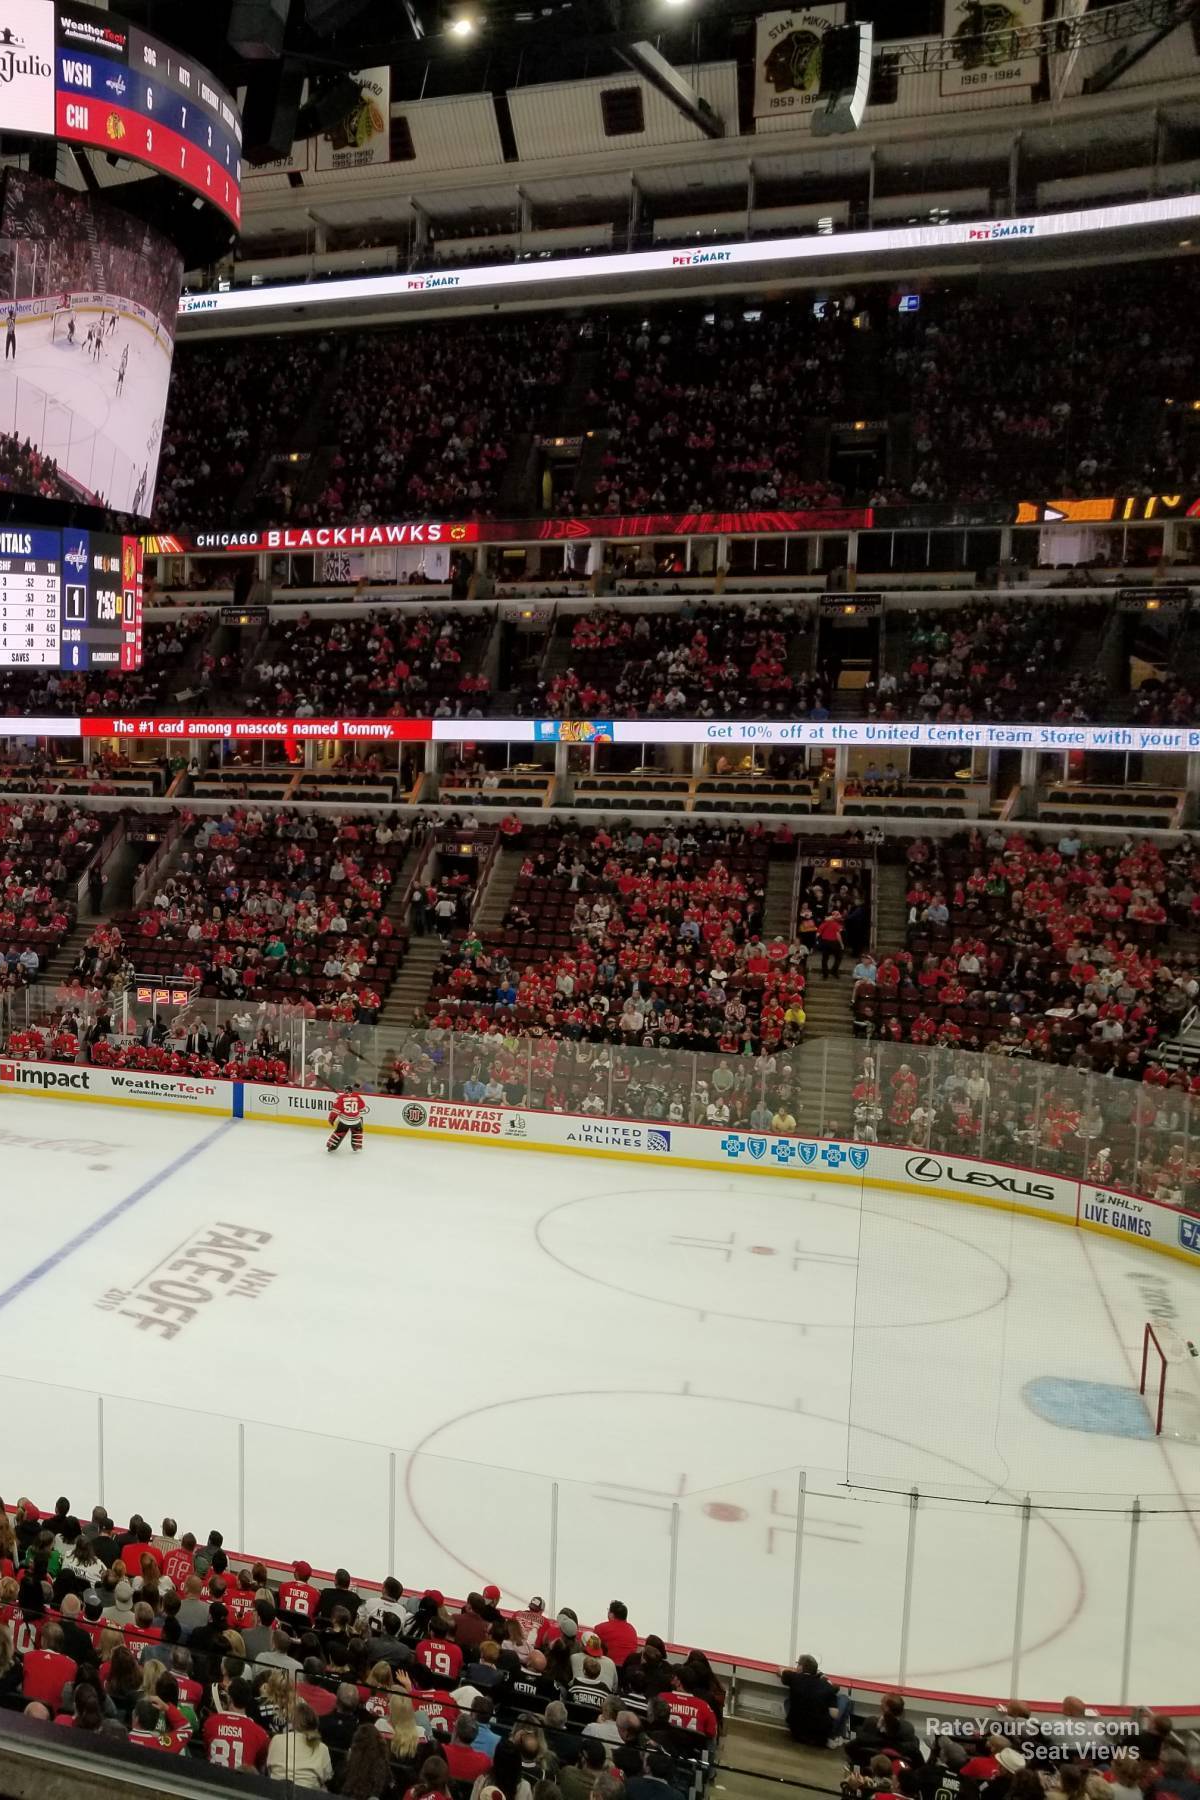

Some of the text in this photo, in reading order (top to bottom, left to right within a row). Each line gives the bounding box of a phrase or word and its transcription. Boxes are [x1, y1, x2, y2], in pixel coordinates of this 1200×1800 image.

[768, 20, 794, 40] STAN
[62, 59, 92, 88] WSH
[66, 104, 89, 131] CHI
[969, 223, 1036, 240] PETSMART
[673, 249, 731, 266] PETSMART
[408, 273, 460, 291] PETSMART
[196, 524, 442, 548] CHICAGO BLACKHAWKS
[113, 720, 394, 738] The #1 card among mascots named Tommy.
[706, 725, 1181, 748] Get 10% off at the United Center Team Store with your
[14, 1062, 90, 1089] impact
[110, 1075, 216, 1096] WeatherTech
[128, 1088, 198, 1101] Automotive Accessories
[261, 1094, 277, 1104] KIA
[343, 1101, 359, 1113] 50
[429, 1105, 504, 1122] FREAKY FAST
[428, 1115, 501, 1135] REWARDS
[582, 1124, 641, 1137] UNITED
[566, 1132, 642, 1148] AIRLINES
[947, 1166, 1055, 1201] LEXUS
[1084, 1203, 1152, 1237] LIVE GAMES
[118, 1220, 273, 1341] FACE-OFF
[226, 1267, 278, 1299] NHL
[167, 1557, 191, 1581] 88
[289, 1587, 309, 1599] TOEWS
[423, 1650, 451, 1676] 19
[513, 1681, 537, 1696] KEITH
[218, 1724, 243, 1739] HOSSA
[209, 1738, 244, 1771] 81
